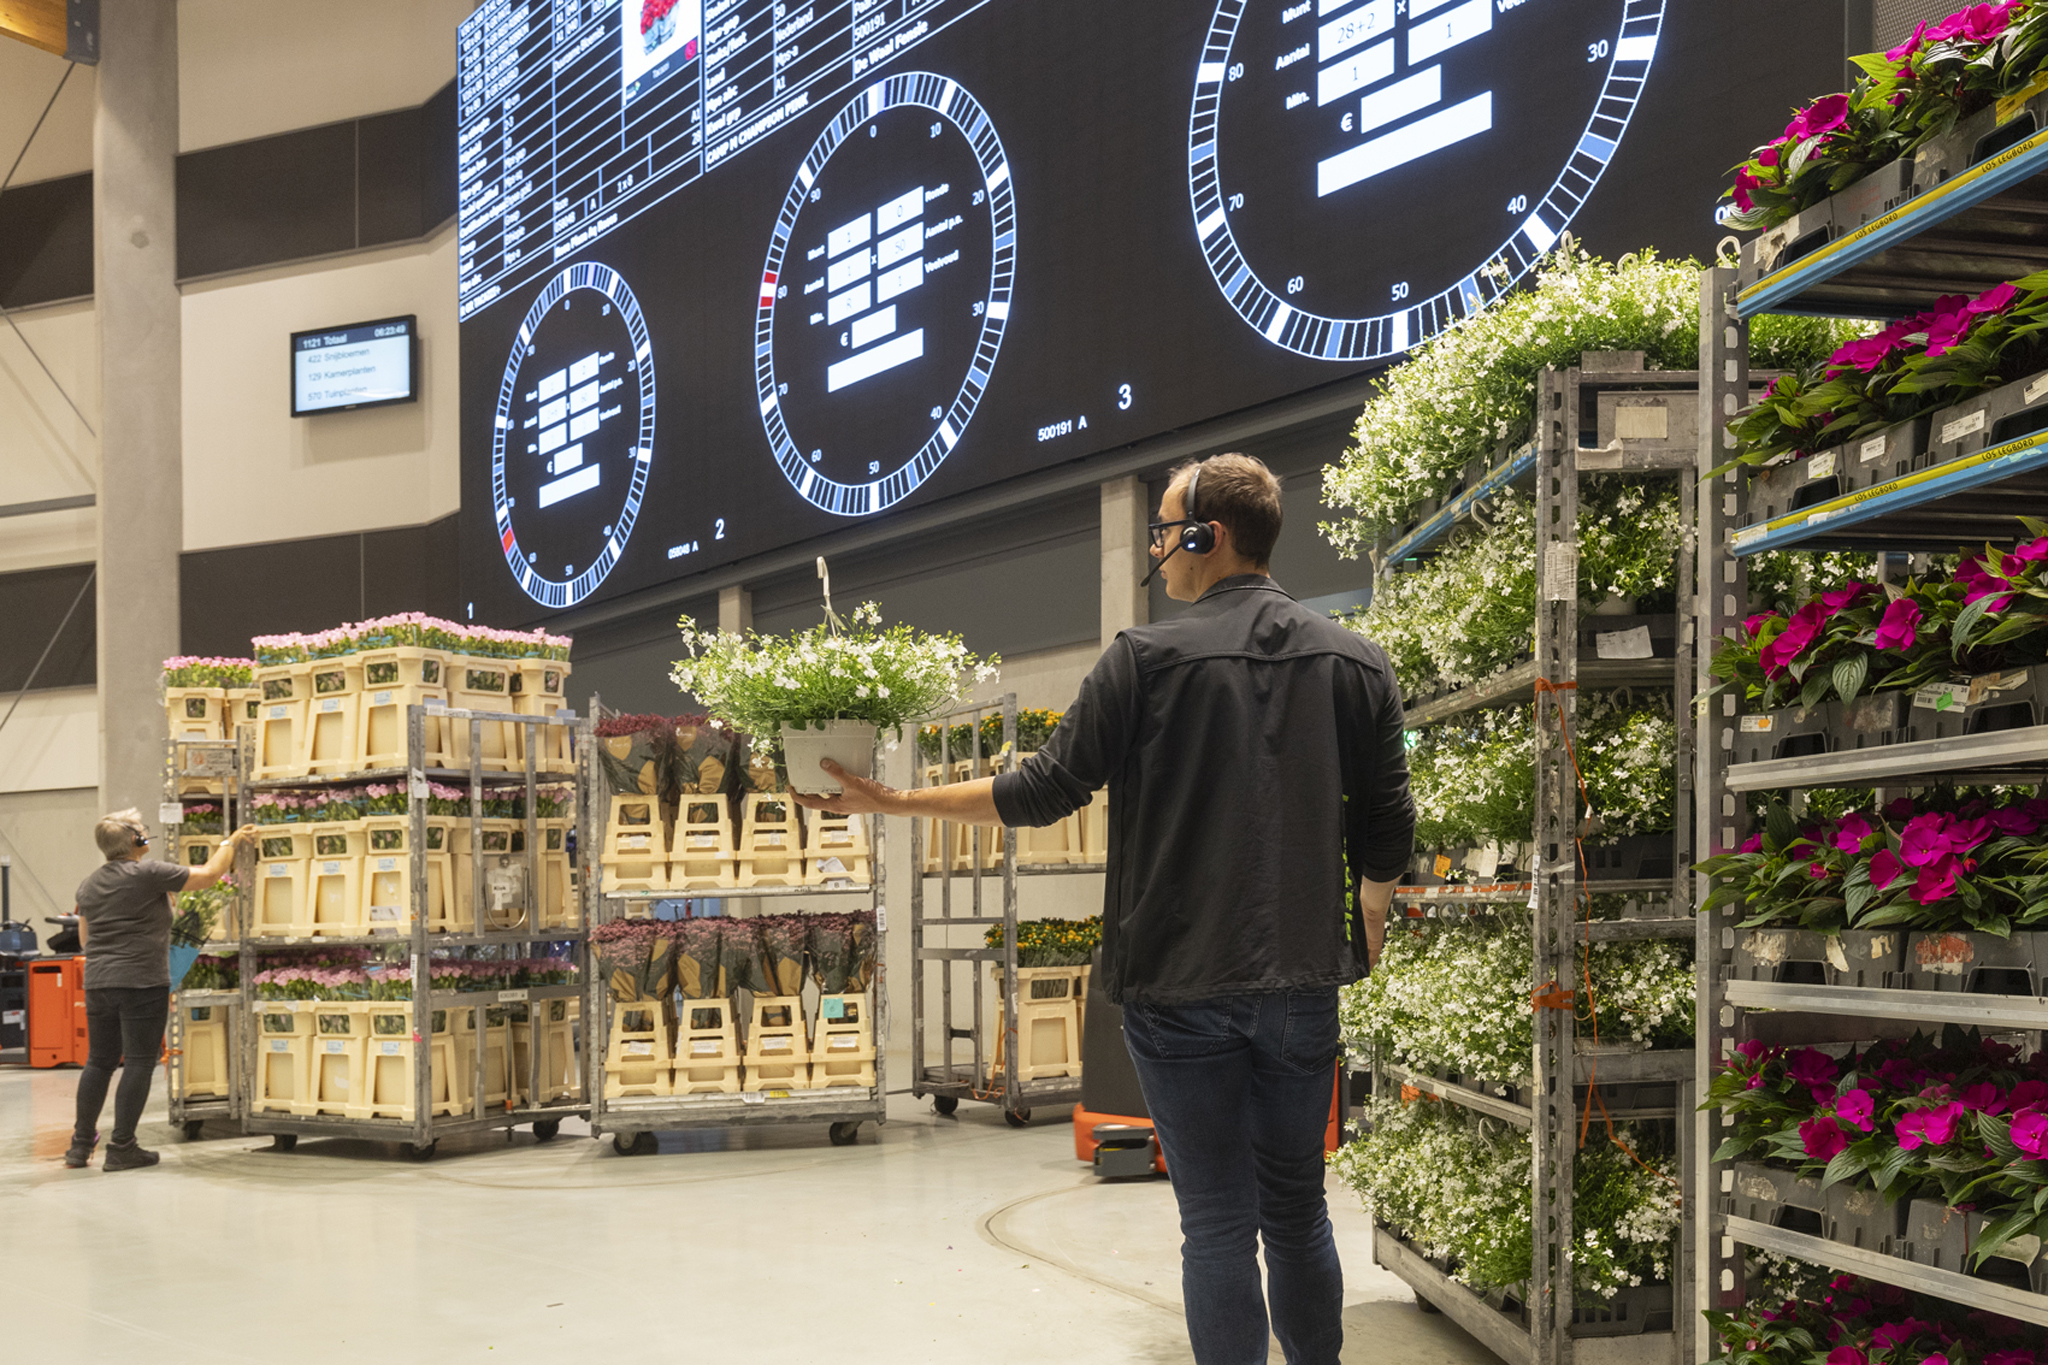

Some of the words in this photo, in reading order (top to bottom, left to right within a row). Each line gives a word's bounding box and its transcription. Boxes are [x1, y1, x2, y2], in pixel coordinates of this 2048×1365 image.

[1282, 0, 1311, 24] Munt
[854, 12, 886, 42] 500191
[1337, 12, 1376, 44] 28+2
[1275, 43, 1310, 70] Aantal
[1587, 40, 1609, 62] 30
[1228, 63, 1244, 82] 80
[785, 91, 809, 117] PINK
[1286, 92, 1310, 110] Min.
[869, 124, 877, 138] 0
[930, 122, 942, 138] 10
[1340, 112, 1354, 132] €
[1982, 160, 1997, 173] LOS
[1998, 140, 2034, 166] LEGBORD
[810, 187, 821, 203] 90
[925, 183, 949, 203] Ronde
[972, 190, 985, 206] 20
[1227, 193, 1244, 212] 70
[1507, 195, 1527, 215] 40
[925, 219, 948, 239] Aantal
[1854, 229, 1867, 240] LOS
[1868, 212, 1898, 235] LEGBORD
[807, 244, 825, 261] Munt
[925, 249, 959, 273] Veelvoud
[777, 285, 788, 300] 80
[804, 277, 824, 294] Aantal
[1287, 276, 1304, 295] 60
[1391, 282, 1409, 302] 50
[564, 299, 570, 311] 0
[602, 303, 611, 317] 10
[972, 301, 985, 317] 30
[303, 338, 321, 348] 1121
[323, 334, 347, 345] Totaal
[308, 355, 321, 363] 422
[628, 360, 636, 372] 20
[308, 373, 321, 381] 129
[777, 382, 788, 397] 70
[1118, 383, 1132, 410] 3
[931, 405, 942, 420] 40
[1037, 419, 1072, 442] 500191
[1078, 415, 1087, 430] A
[811, 448, 822, 464] 60
[1981, 449, 1997, 462] LOS
[1998, 437, 2035, 457] LEGBORD
[869, 460, 879, 475] 50
[1854, 492, 1870, 502] LOS
[1871, 482, 1898, 499] LEGBORD
[715, 518, 725, 540] 2
[692, 540, 699, 552] A
[565, 564, 573, 576] 50
[467, 602, 473, 620] 1
